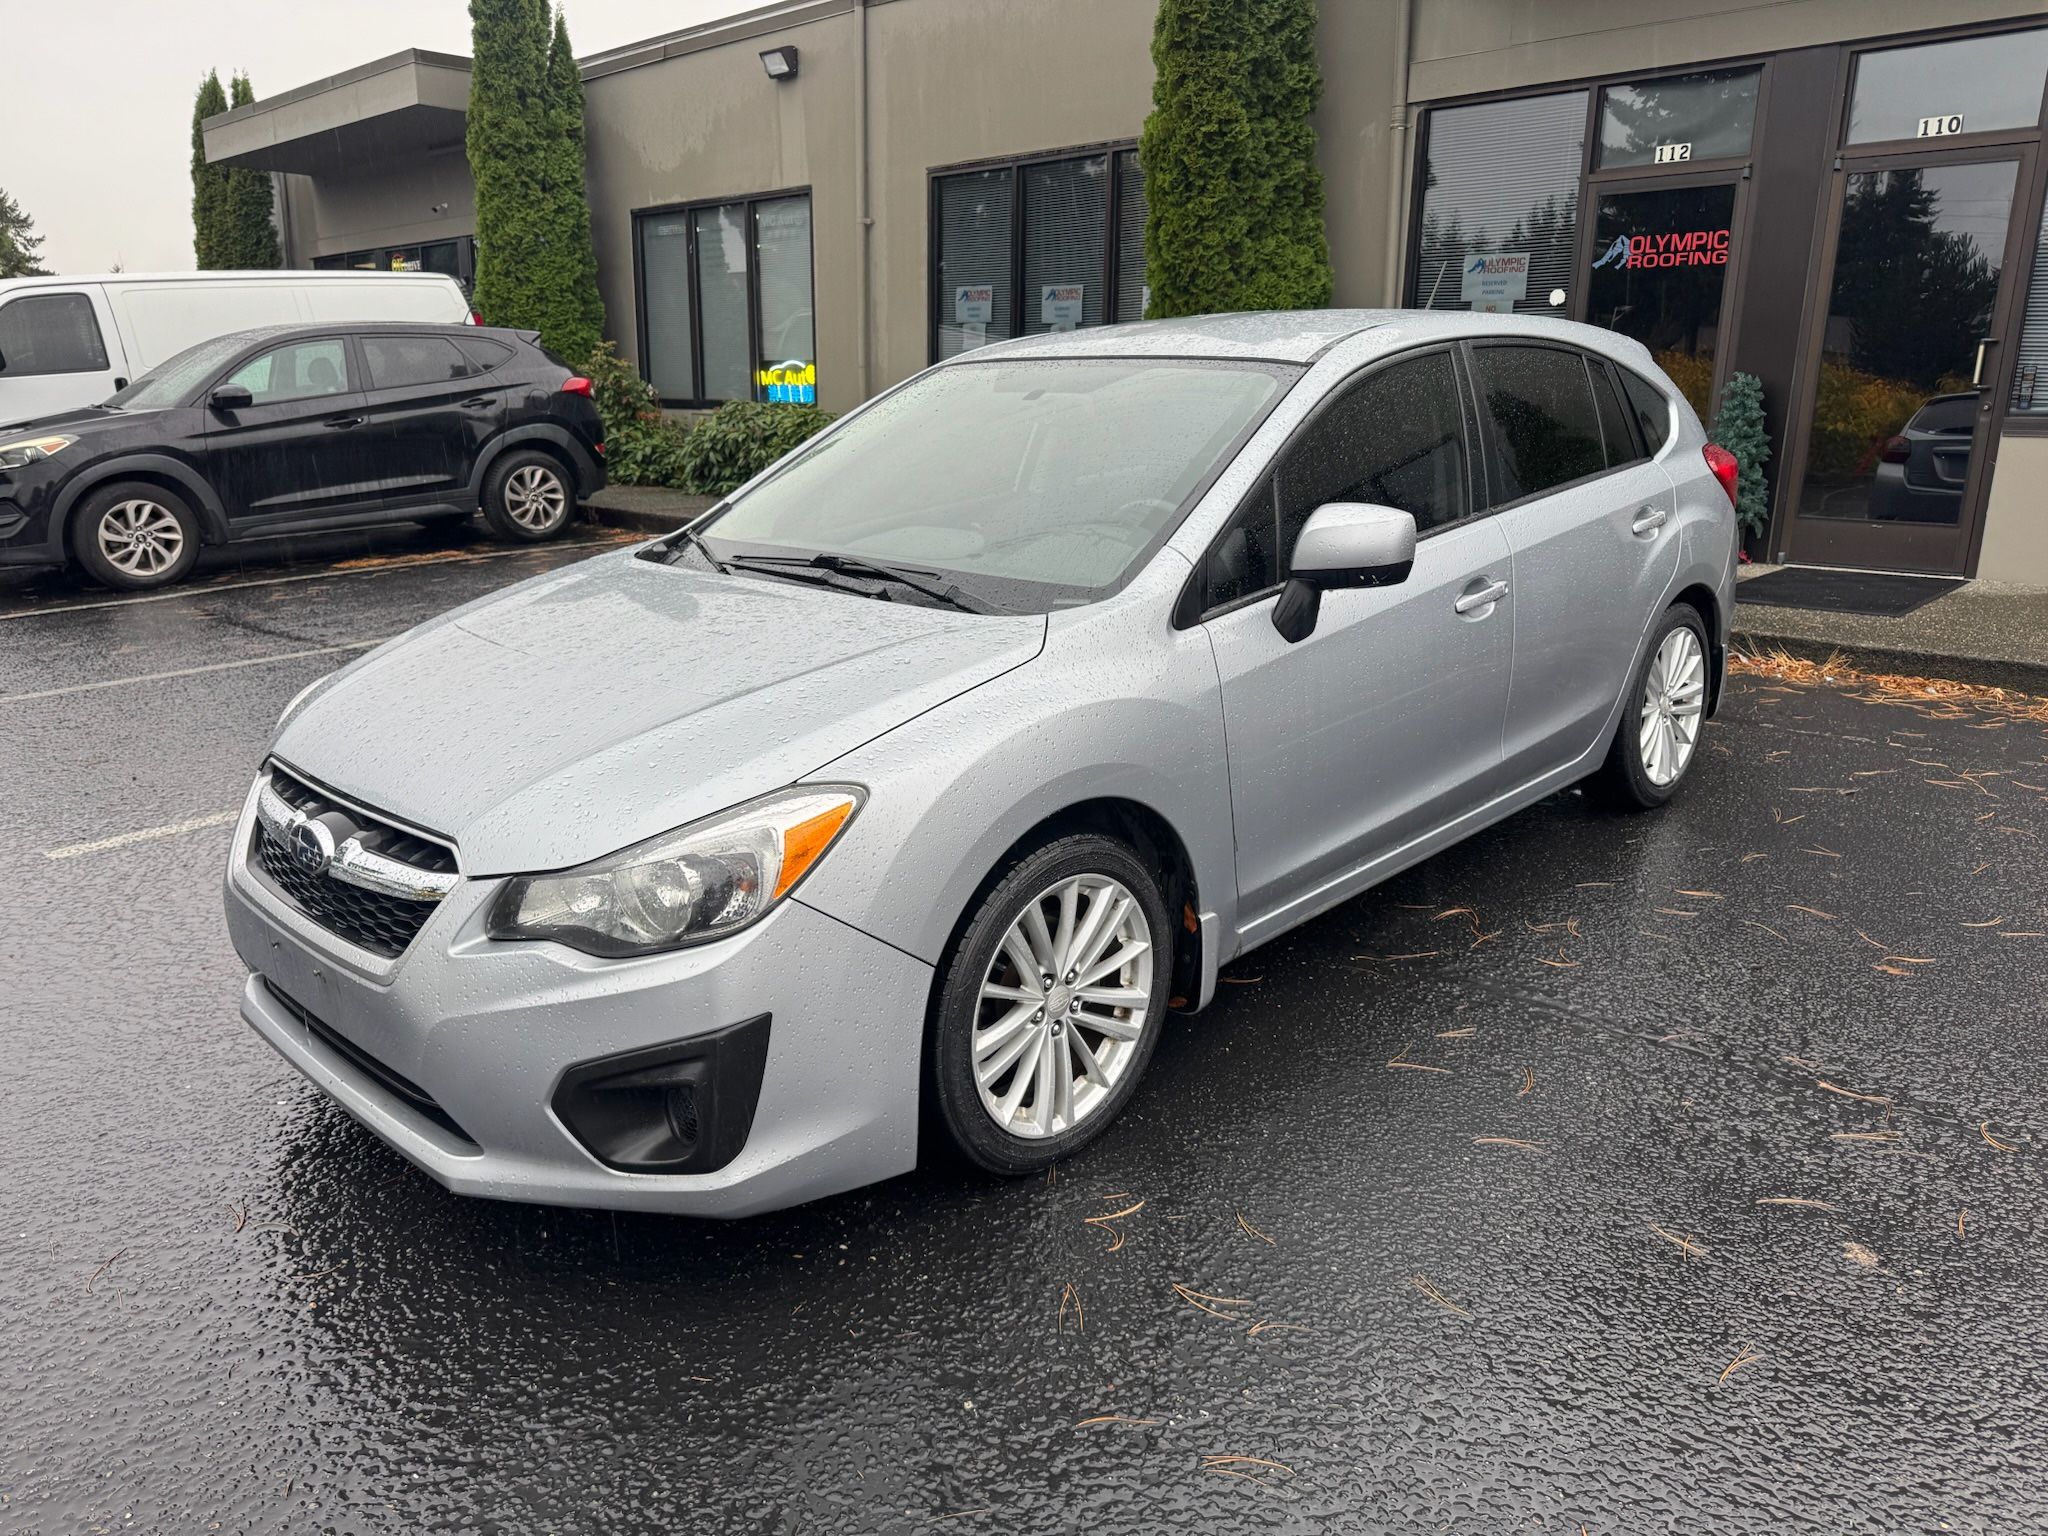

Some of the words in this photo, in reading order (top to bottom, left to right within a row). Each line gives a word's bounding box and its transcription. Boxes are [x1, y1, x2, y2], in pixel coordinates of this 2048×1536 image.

[1921, 116, 1961, 136] 110
[1658, 145, 1689, 162] 112
[1629, 230, 1730, 254] OLYMPIC
[1483, 257, 1526, 267] OLYMPIC
[1626, 250, 1729, 270] ROOFING
[1483, 265, 1526, 274] ROOFING
[760, 369, 783, 386] MC
